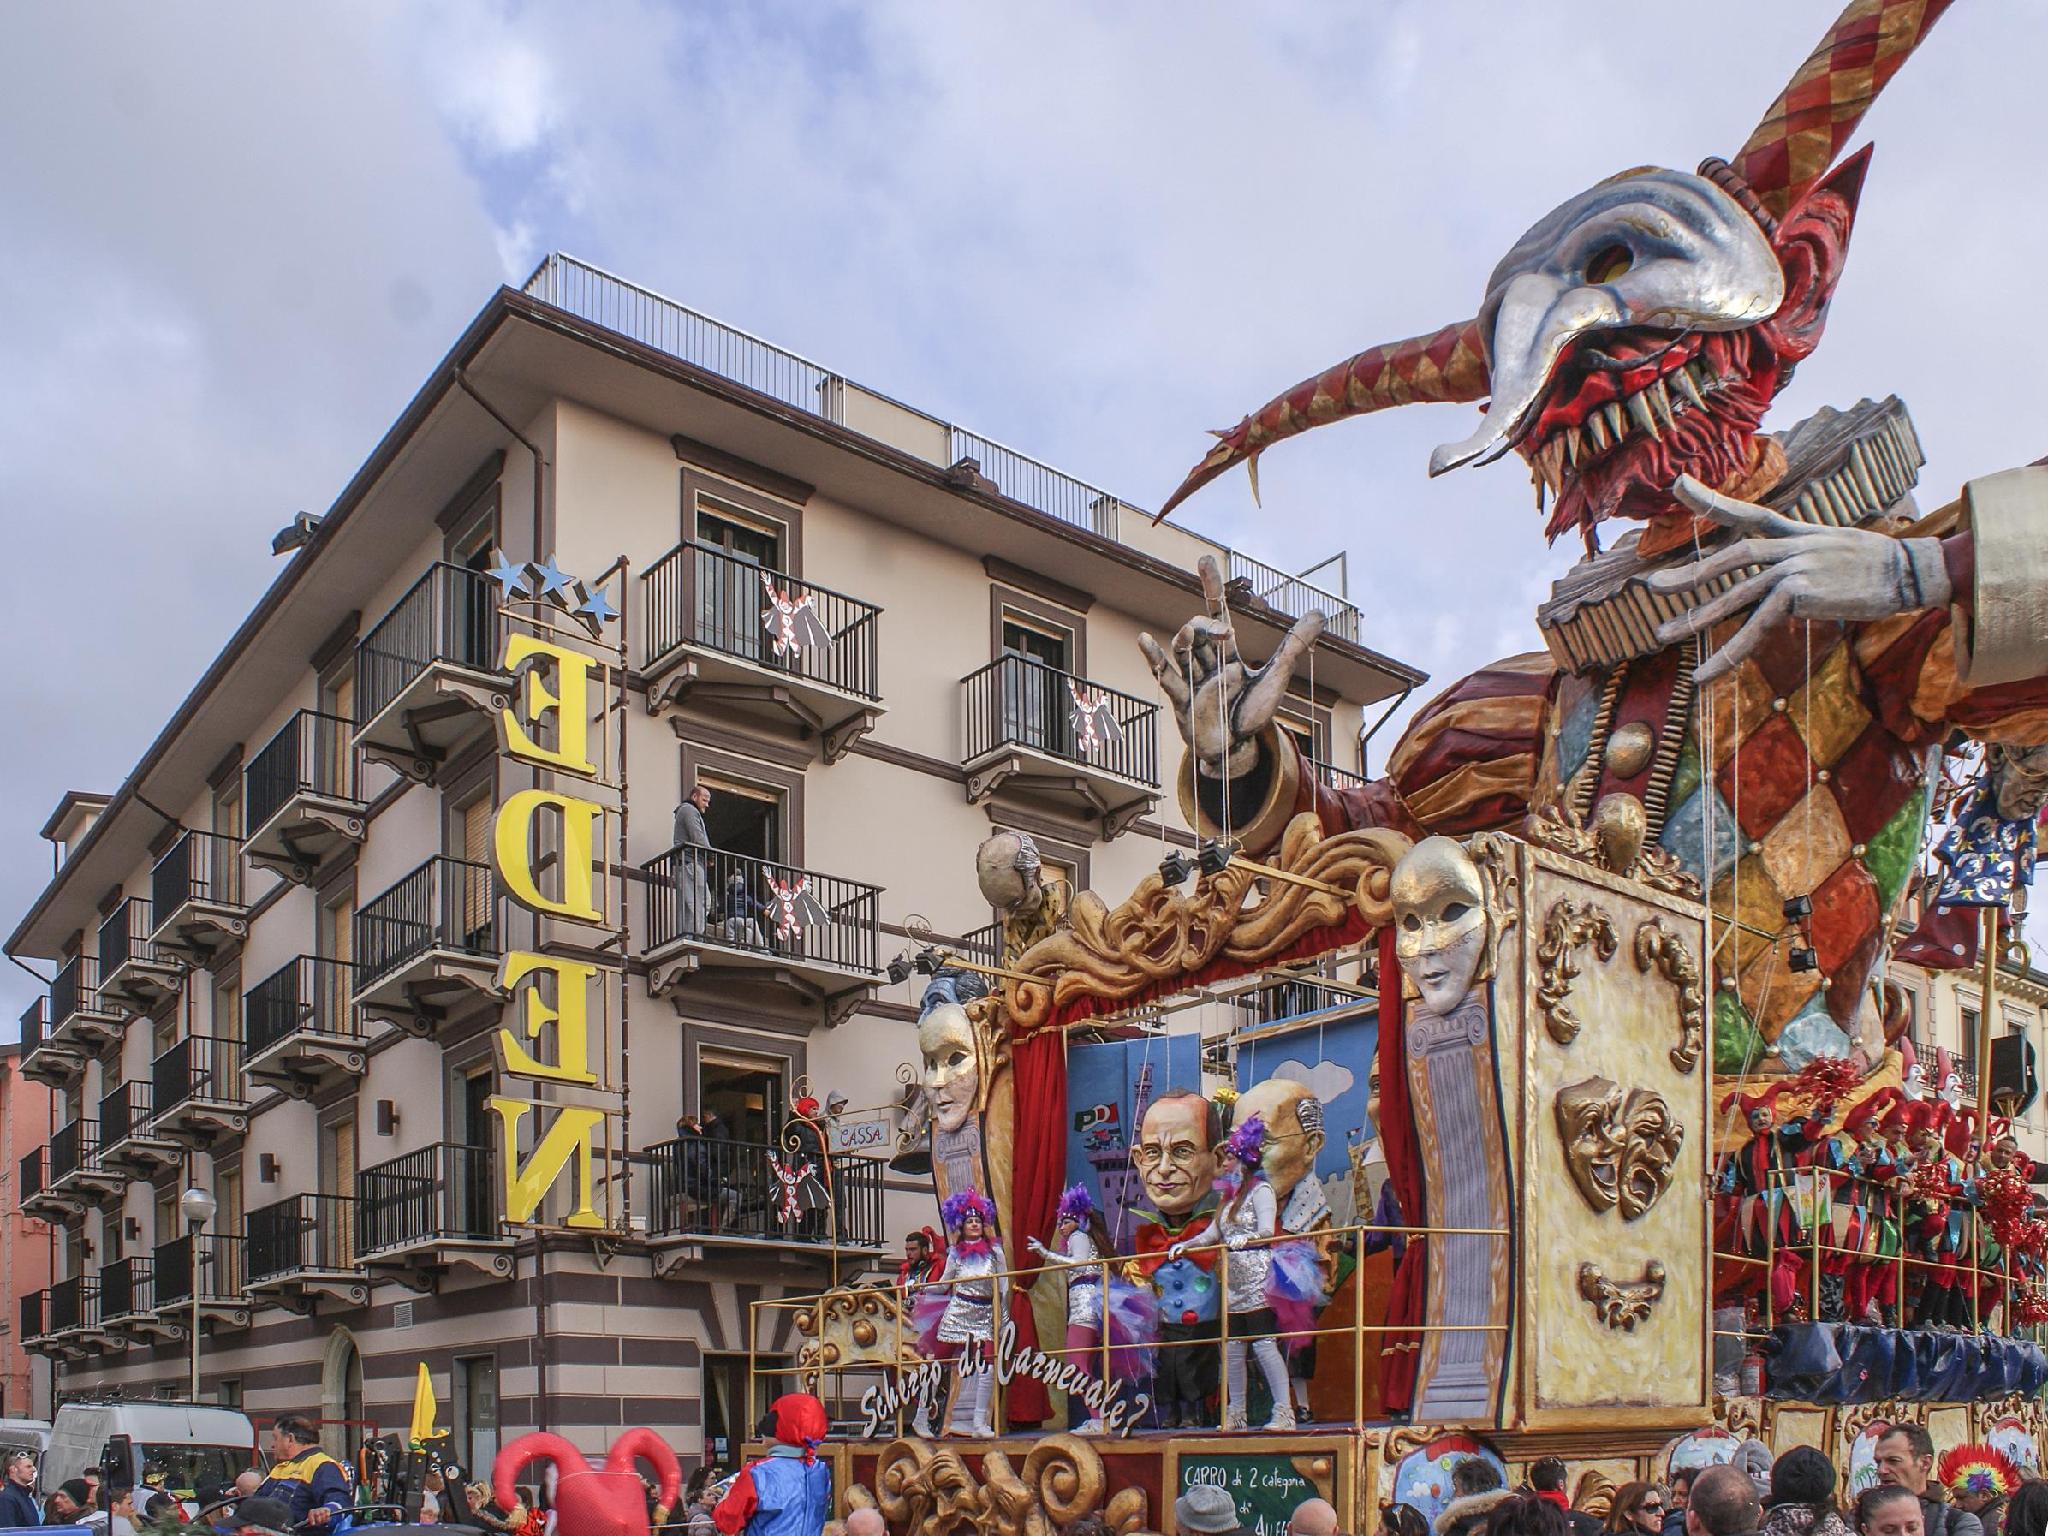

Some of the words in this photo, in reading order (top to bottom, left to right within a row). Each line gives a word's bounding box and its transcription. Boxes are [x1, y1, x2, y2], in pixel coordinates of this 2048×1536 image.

[840, 1127, 883, 1147] CASSA
[959, 1332, 986, 1378] di
[1184, 1465, 1227, 1488] CARRO
[1232, 1467, 1242, 1486] di
[1249, 1466, 1258, 1488] 2
